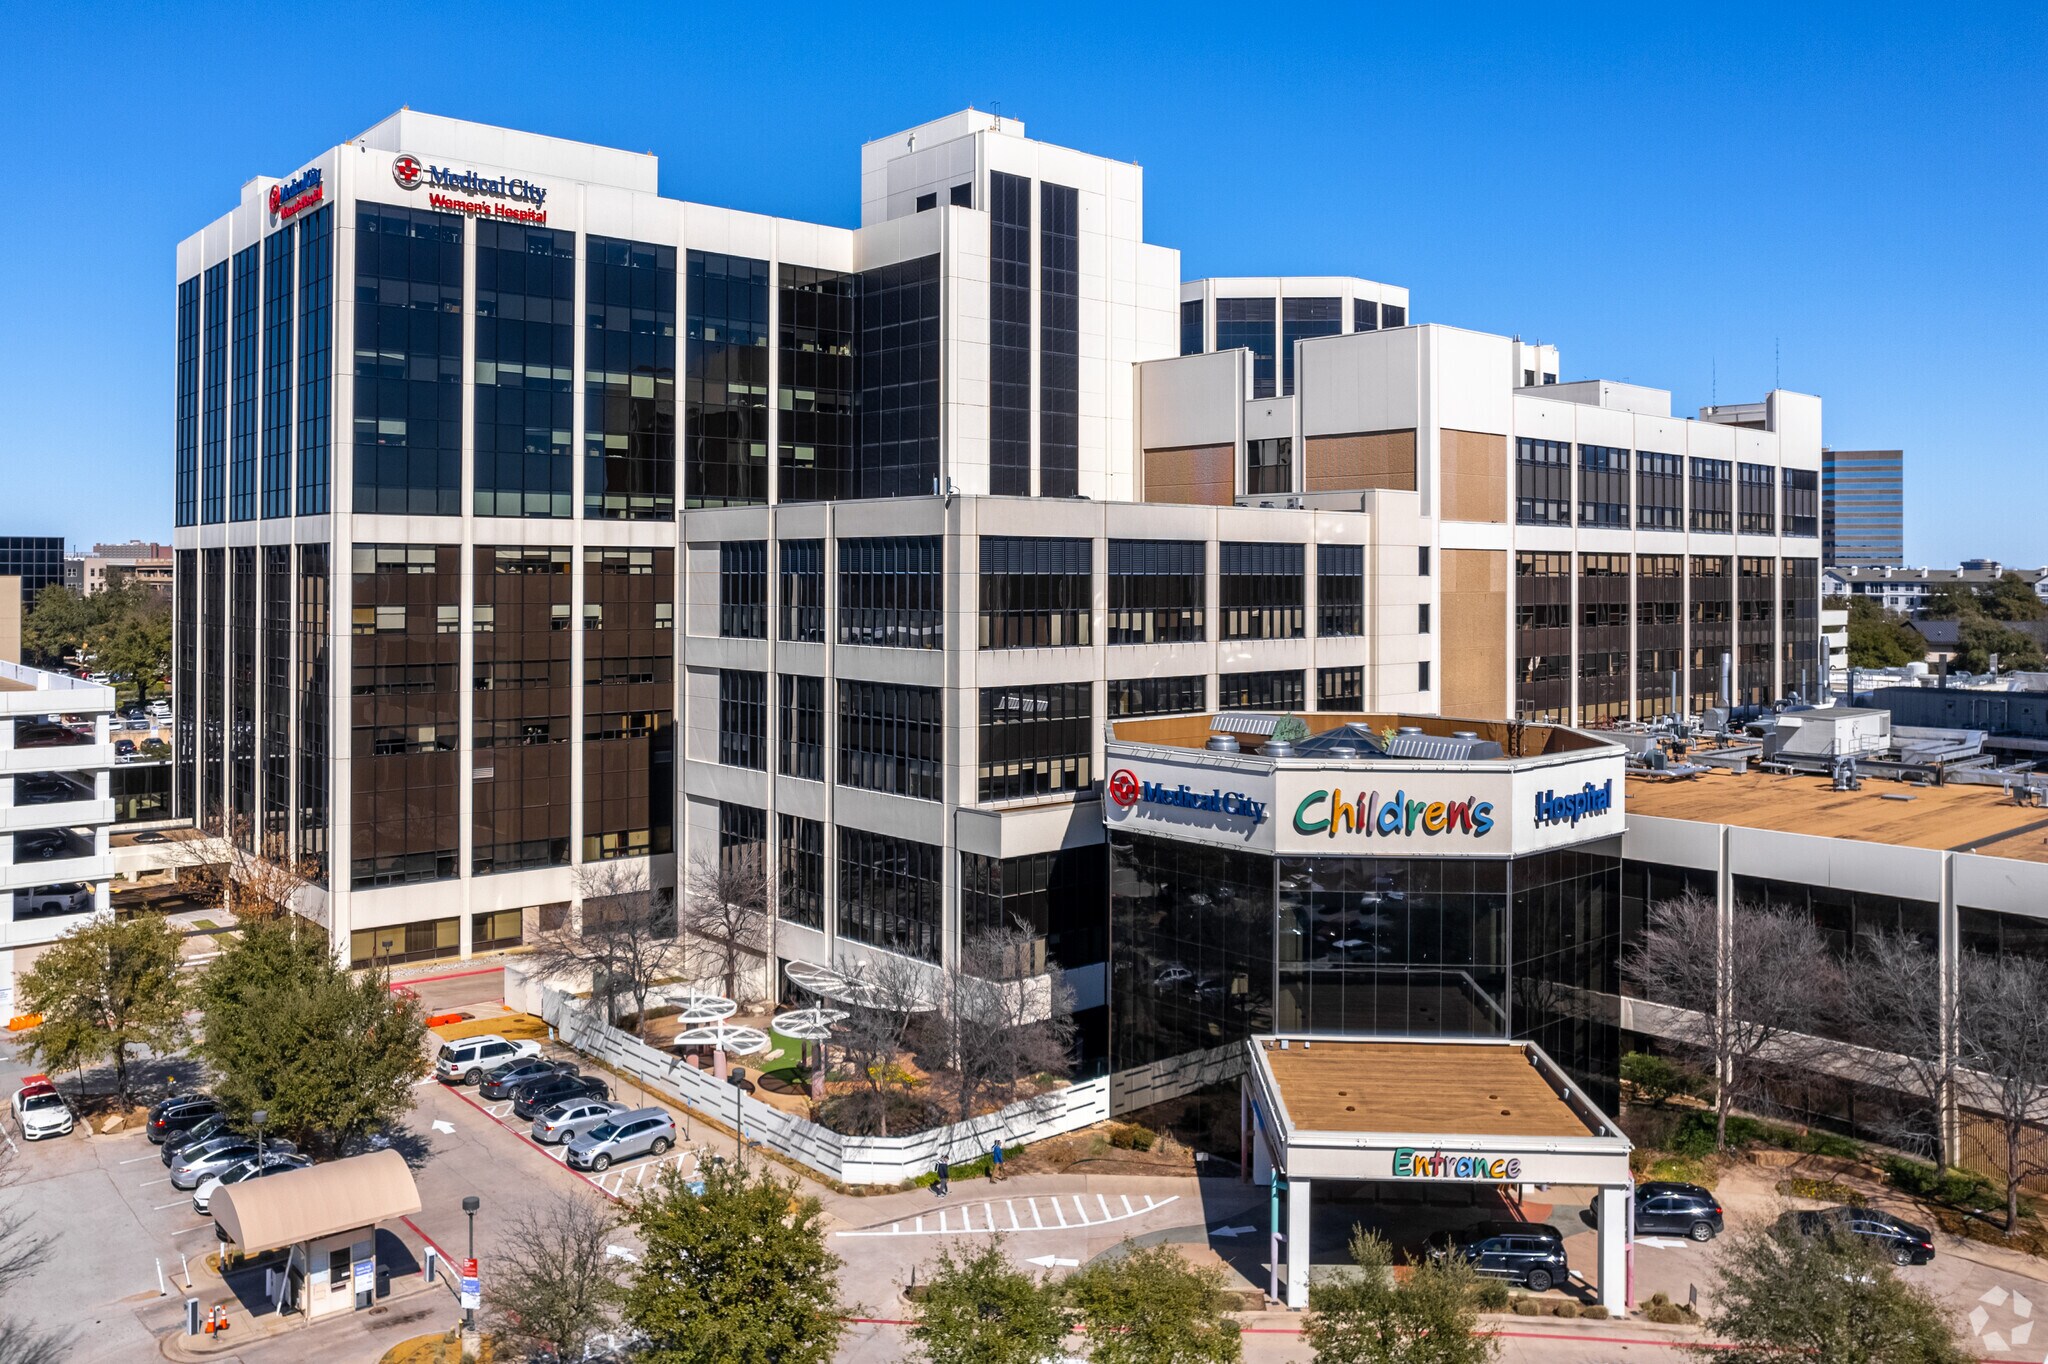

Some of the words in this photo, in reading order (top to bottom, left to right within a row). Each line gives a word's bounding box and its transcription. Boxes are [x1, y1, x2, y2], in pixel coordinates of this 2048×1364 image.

[430, 165, 505, 194] Medical
[509, 179, 547, 206] City
[429, 192, 491, 214] Women's
[495, 203, 546, 222] Hospital
[1143, 781, 1221, 812] Medical
[1223, 791, 1267, 825] City
[1294, 788, 1494, 835] Children's
[1535, 779, 1612, 823] Hospital
[1393, 1147, 1522, 1178] Entrance
